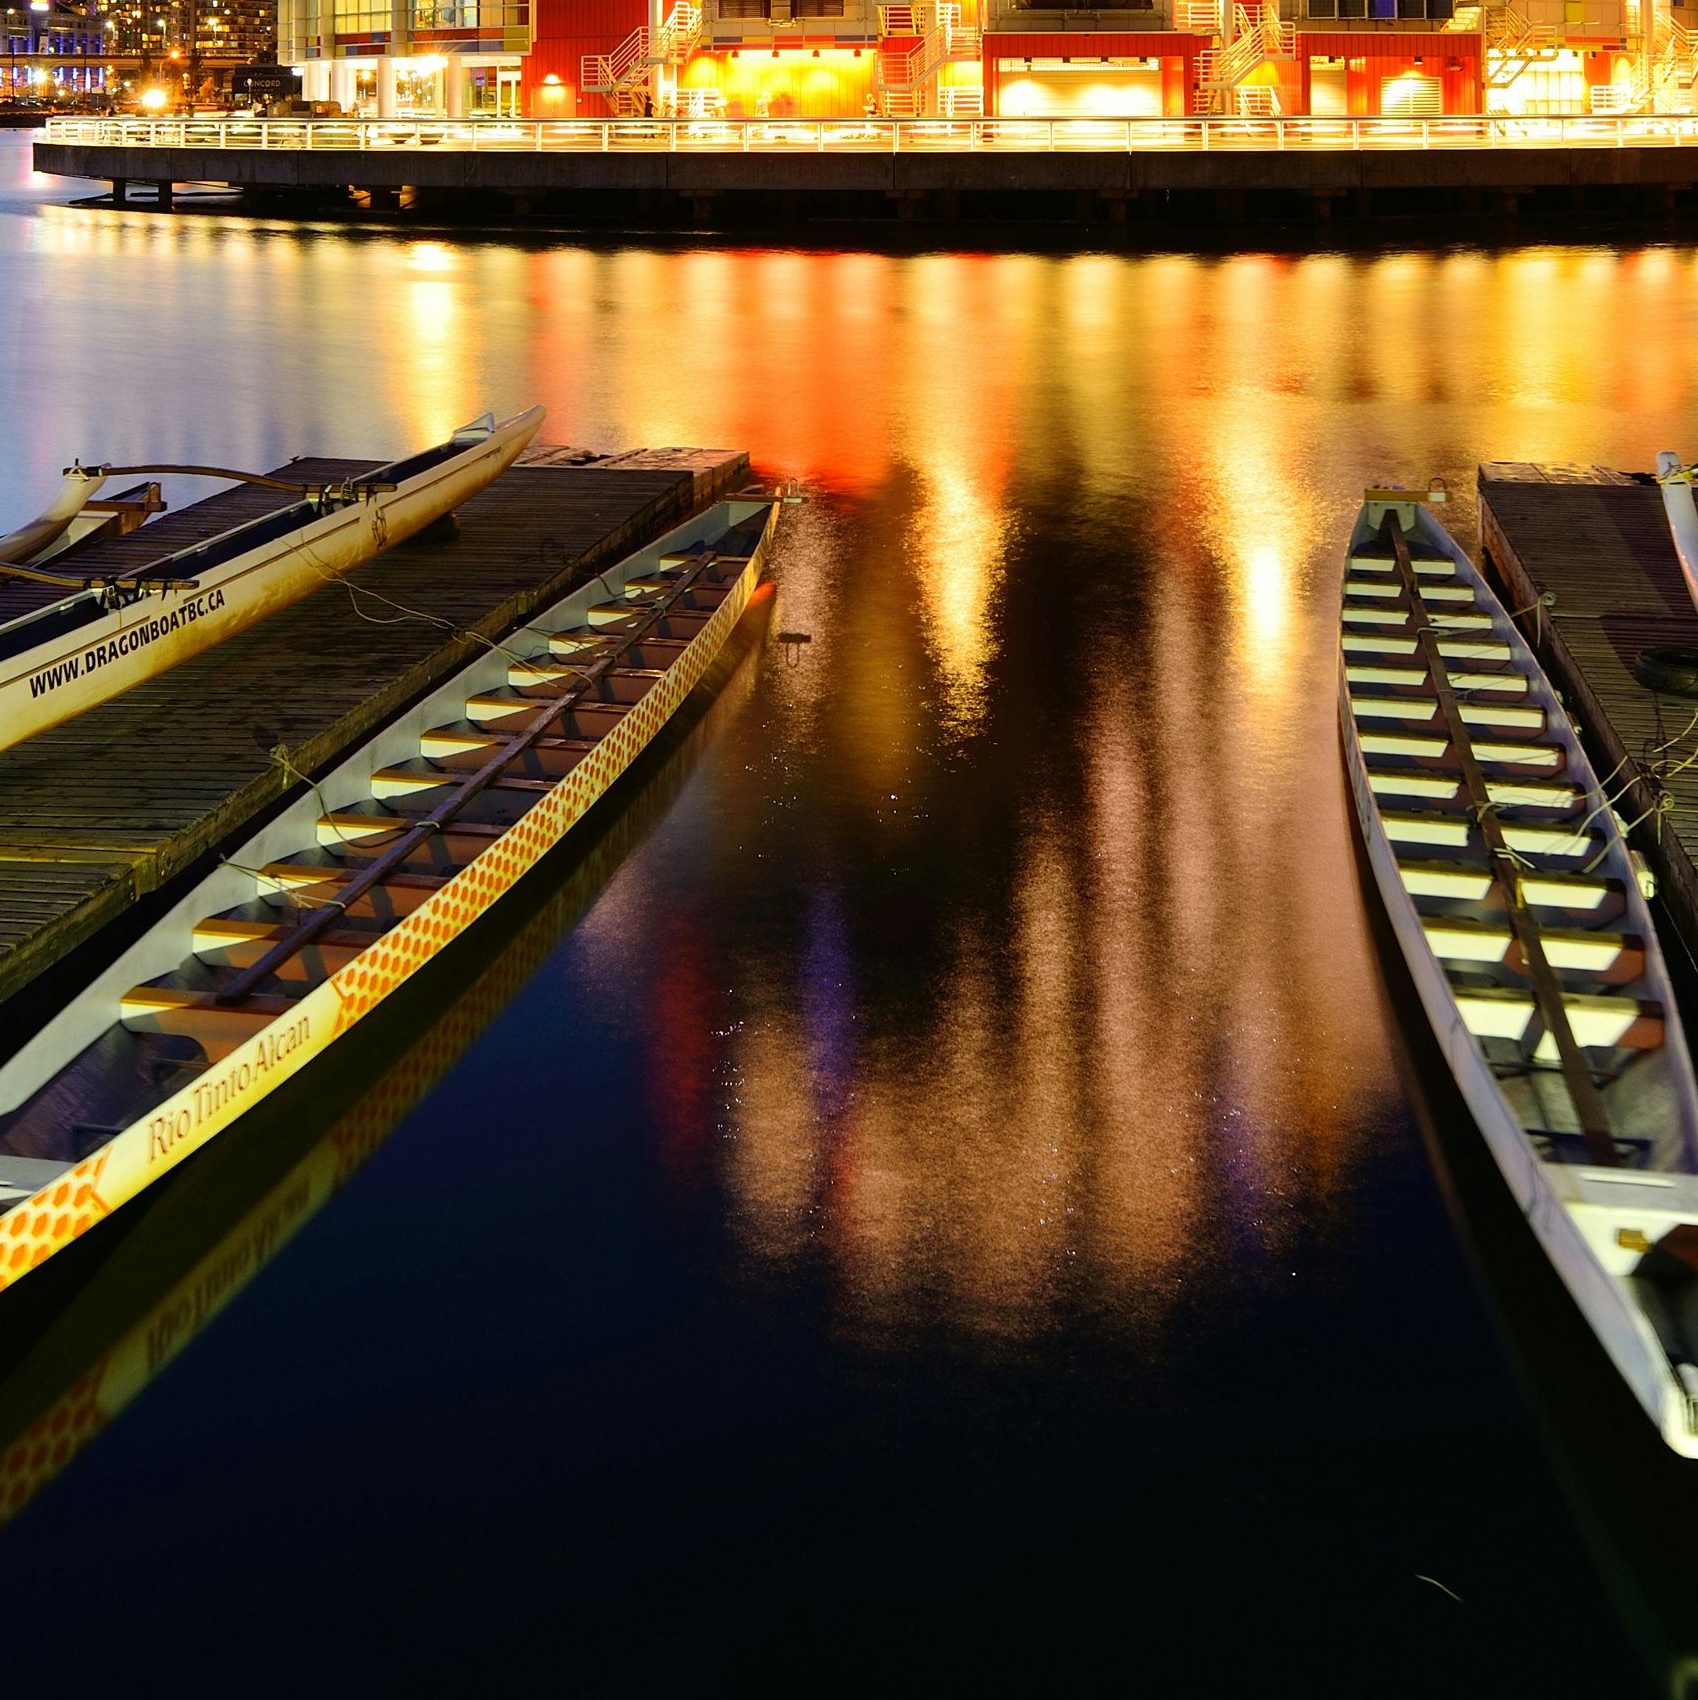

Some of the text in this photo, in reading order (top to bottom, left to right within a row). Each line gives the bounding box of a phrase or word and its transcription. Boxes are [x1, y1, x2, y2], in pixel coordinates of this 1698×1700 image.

[29, 589, 225, 698] WWW.DRAGONBOATBC.CA
[149, 1016, 311, 1163] Rio Tinto Alcan
